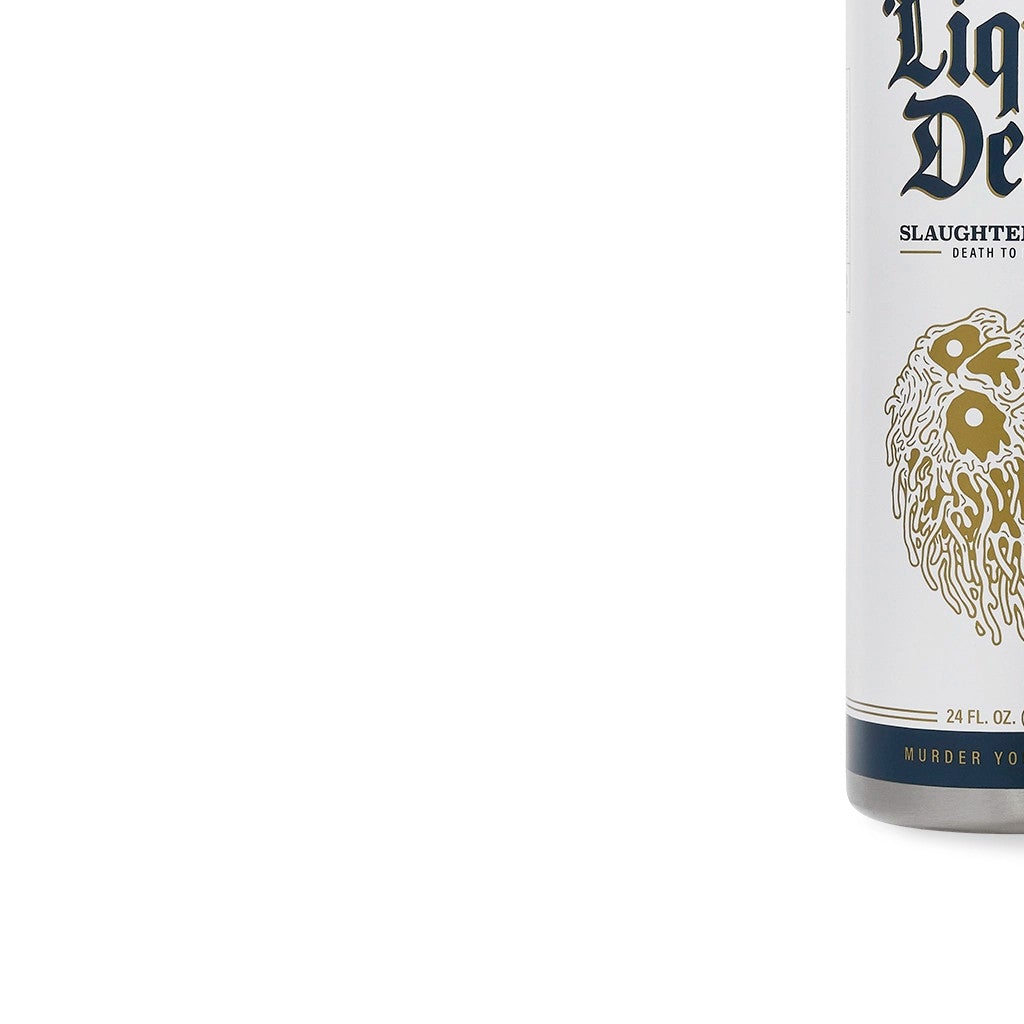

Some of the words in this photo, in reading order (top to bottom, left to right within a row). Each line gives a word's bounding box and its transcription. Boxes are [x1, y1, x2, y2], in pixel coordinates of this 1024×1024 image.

[952, 247, 994, 259] DEATH
[1001, 247, 1016, 259] TO
[946, 708, 963, 724] 24
[967, 709, 988, 725] FL.
[993, 709, 1016, 725] OZ.
[904, 747, 981, 765] MURDER
